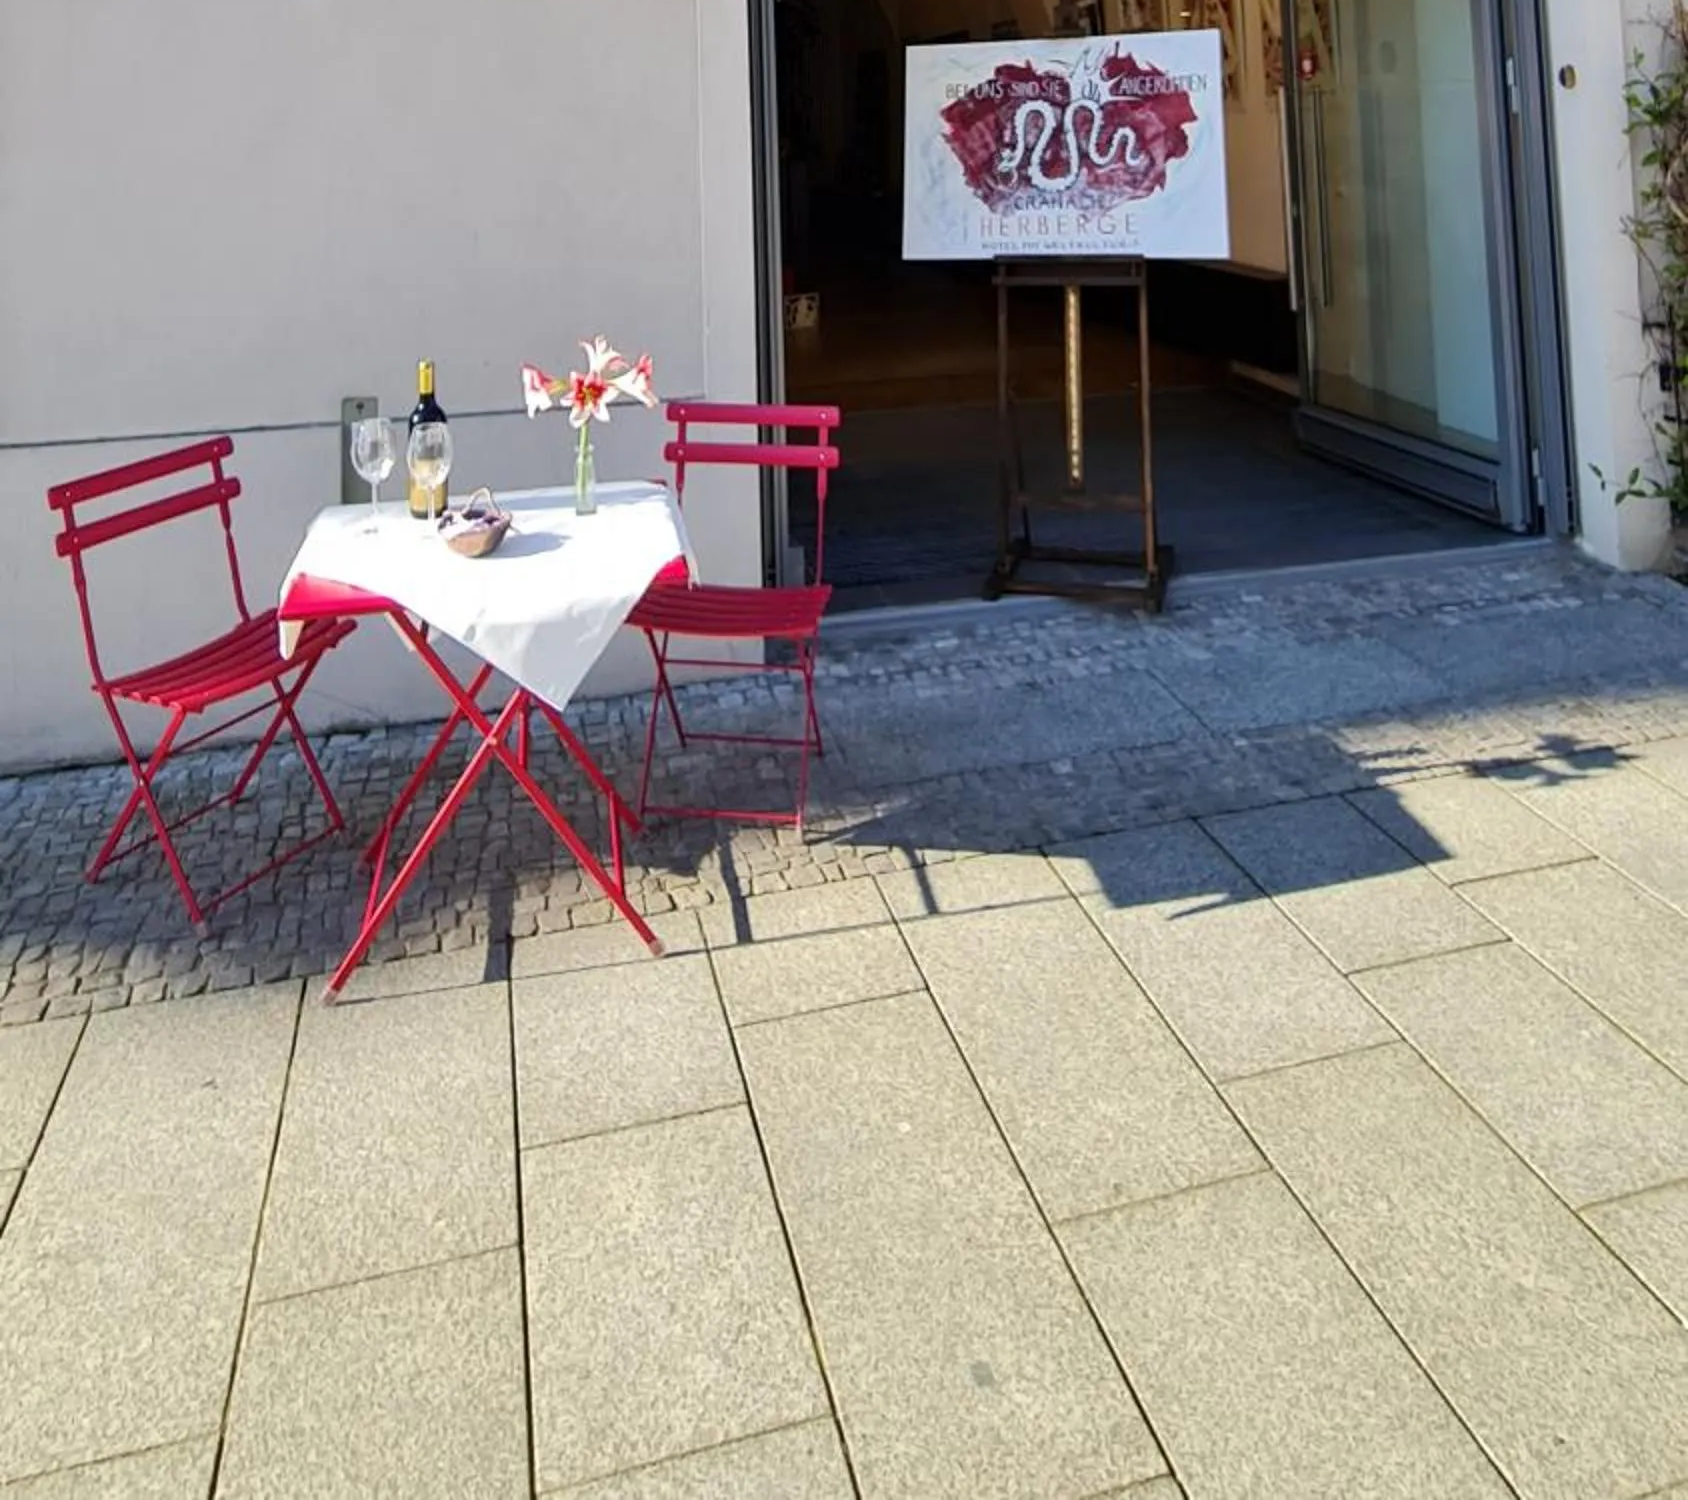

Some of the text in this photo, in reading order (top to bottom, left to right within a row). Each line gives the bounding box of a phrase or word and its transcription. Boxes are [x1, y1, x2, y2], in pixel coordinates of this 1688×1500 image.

[944, 83, 969, 100] BEI
[974, 80, 1005, 100] UNS
[1040, 78, 1064, 98] SIE
[980, 212, 1140, 238] HERBERGE
